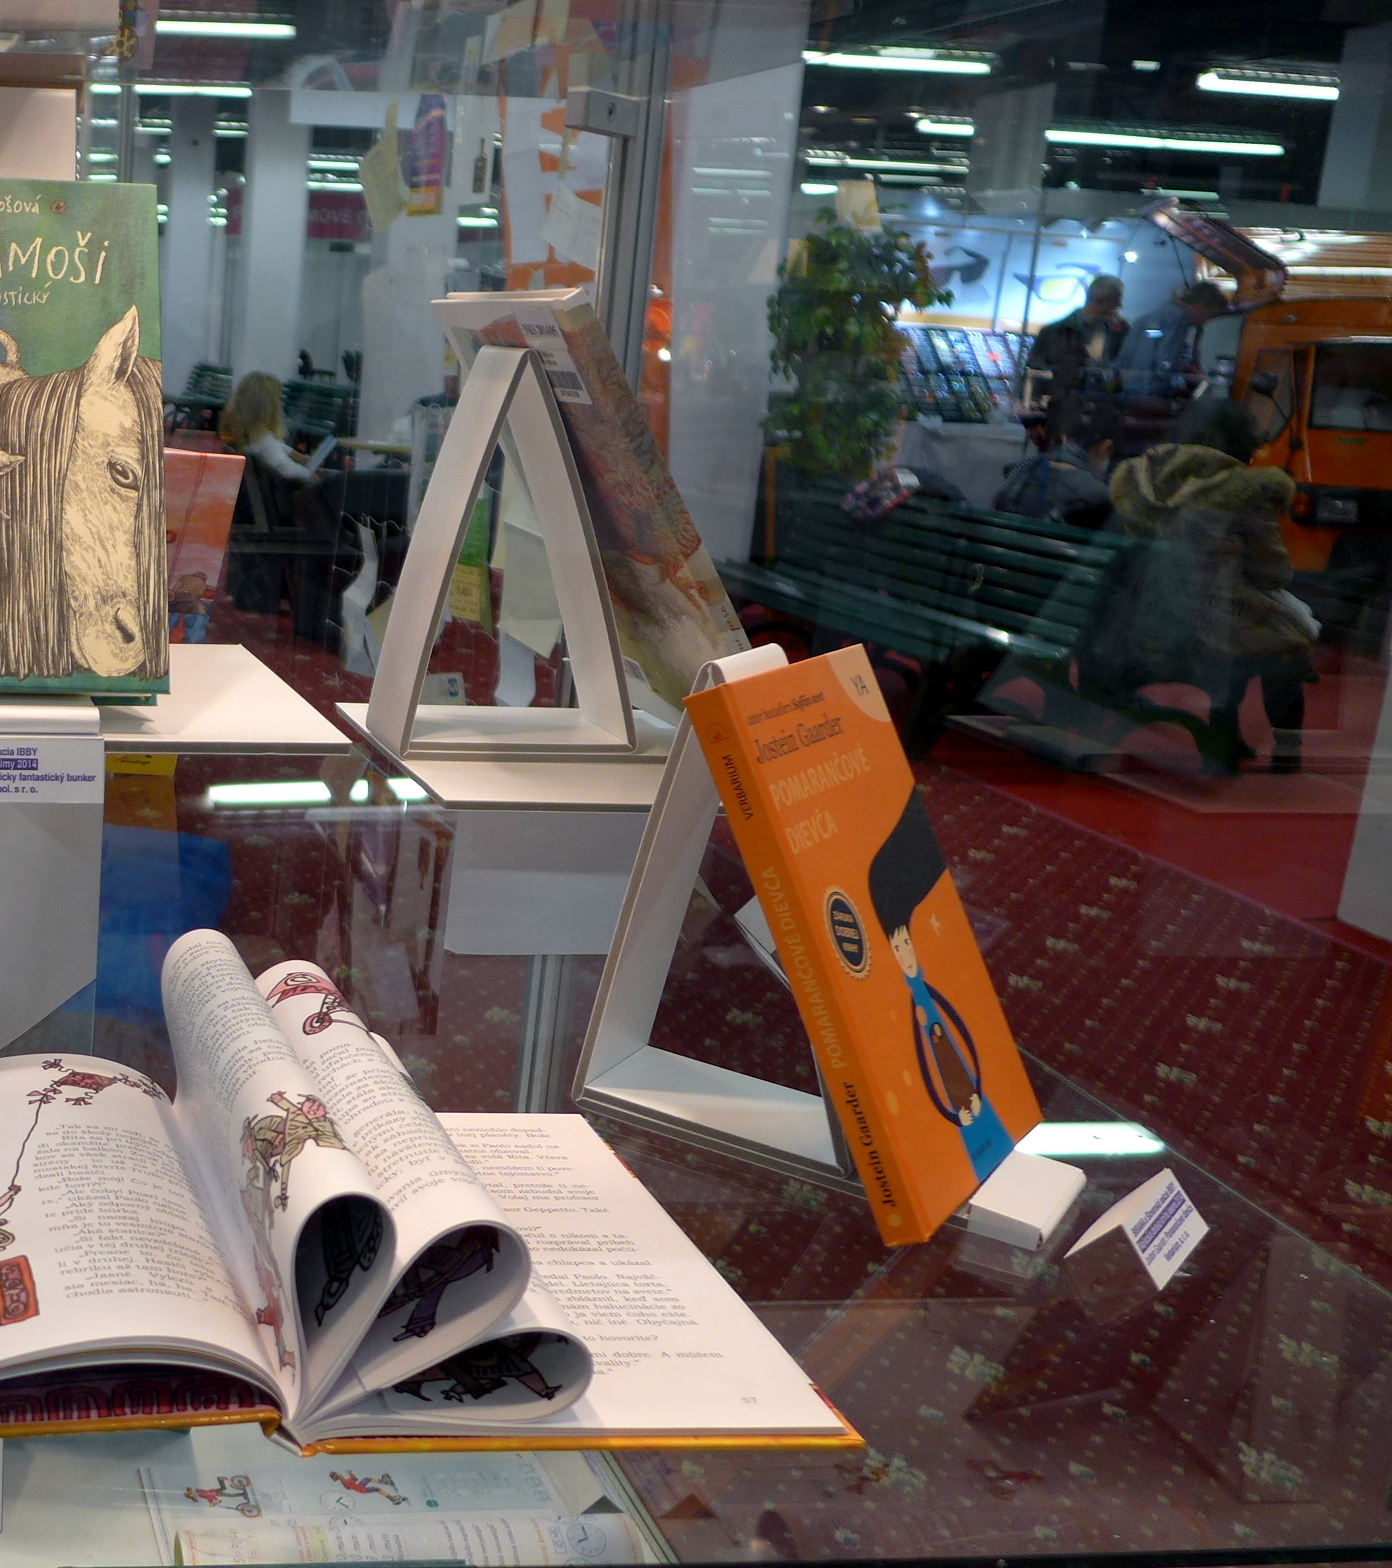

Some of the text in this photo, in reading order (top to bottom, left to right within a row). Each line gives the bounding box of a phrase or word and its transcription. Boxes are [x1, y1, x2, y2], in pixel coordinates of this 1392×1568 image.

[849, 674, 870, 697] YA
[753, 712, 844, 765] Jostein Gaarder
[16, 747, 38, 756] IBBY
[16, 759, 37, 769] 2014
[19, 772, 65, 784] fantastický
[66, 773, 96, 782] bunker
[768, 743, 871, 811] POMARANČOVÉ
[722, 754, 754, 821] VERBARIUM
[785, 809, 839, 856] DIEVČA
[761, 866, 847, 1070] POMARANČOVÉ DIEVČA
[843, 1081, 896, 1207] Jostein Gaarder
[60, 1264, 163, 1275] rebríku tam
[547, 1259, 596, 1267] chlapca
[584, 1318, 699, 1327] nič Obyčajná
[626, 1310, 658, 1318] čoho
